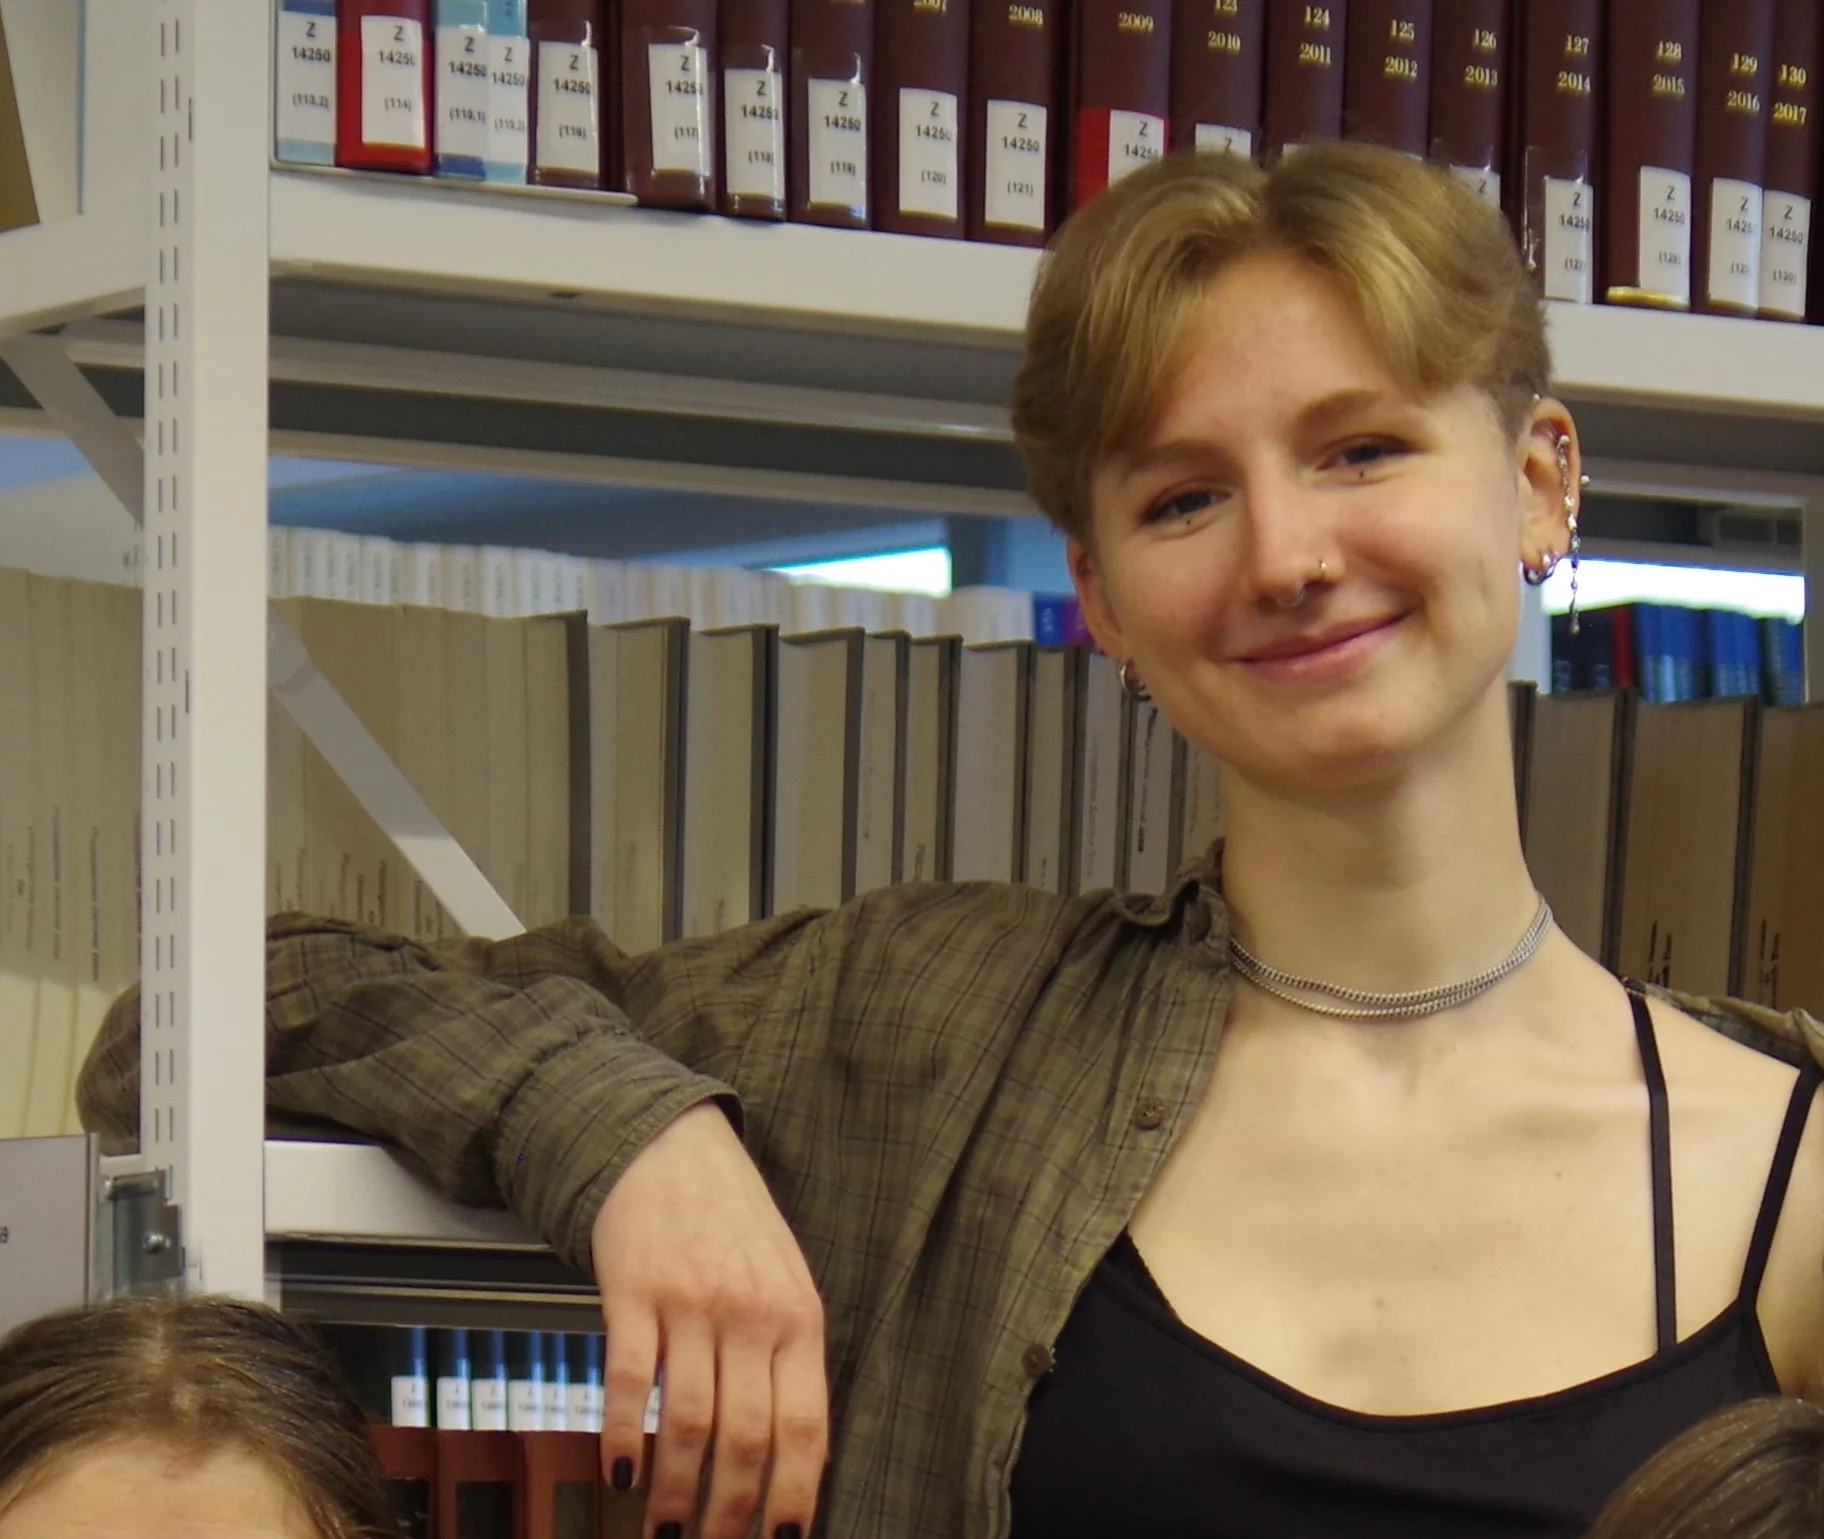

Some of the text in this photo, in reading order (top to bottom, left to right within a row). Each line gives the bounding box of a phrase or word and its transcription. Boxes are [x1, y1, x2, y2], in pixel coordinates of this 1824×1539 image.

[1008, 5, 1044, 26] 2008
[1118, 12, 1155, 33] 2009
[1304, 5, 1331, 26] 124
[306, 21, 316, 38] Z
[393, 25, 405, 42] Z
[1390, 19, 1416, 41] 125
[464, 36, 475, 53] Z
[1207, 30, 1242, 51] 2010
[1474, 28, 1497, 50] 126
[1565, 34, 1590, 55] 127
[292, 46, 331, 63] 14250
[504, 47, 514, 62] Z
[1299, 42, 1332, 65] 2011
[1657, 40, 1682, 60] 128
[448, 60, 487, 78] 14250
[569, 54, 580, 71] Z
[680, 55, 690, 72] Z
[1384, 56, 1419, 78] 2012
[1732, 53, 1758, 73] 129
[491, 71, 525, 87] 14250
[1465, 65, 1499, 86] 2013
[1557, 71, 1591, 92] 2014
[1780, 64, 1807, 86] 130
[553, 78, 591, 95] 14250
[756, 80, 767, 96] Z
[1652, 74, 1685, 95] 2015
[838, 91, 849, 107] Z
[1727, 91, 1761, 112] 2016
[929, 101, 940, 118] Z
[1773, 102, 1808, 125] 2017
[823, 114, 862, 132] 14250
[1018, 112, 1028, 129] Z
[1139, 121, 1149, 137] Z
[914, 123, 952, 143] 14250
[1001, 135, 1041, 154] 14250
[1572, 192, 1581, 207] Z
[1666, 186, 1675, 201] Z
[1740, 197, 1748, 211] Z
[1784, 205, 1794, 220] Z
[1653, 208, 1686, 224] 14250
[1726, 218, 1755, 234] 1425
[1769, 227, 1804, 245] 14250
